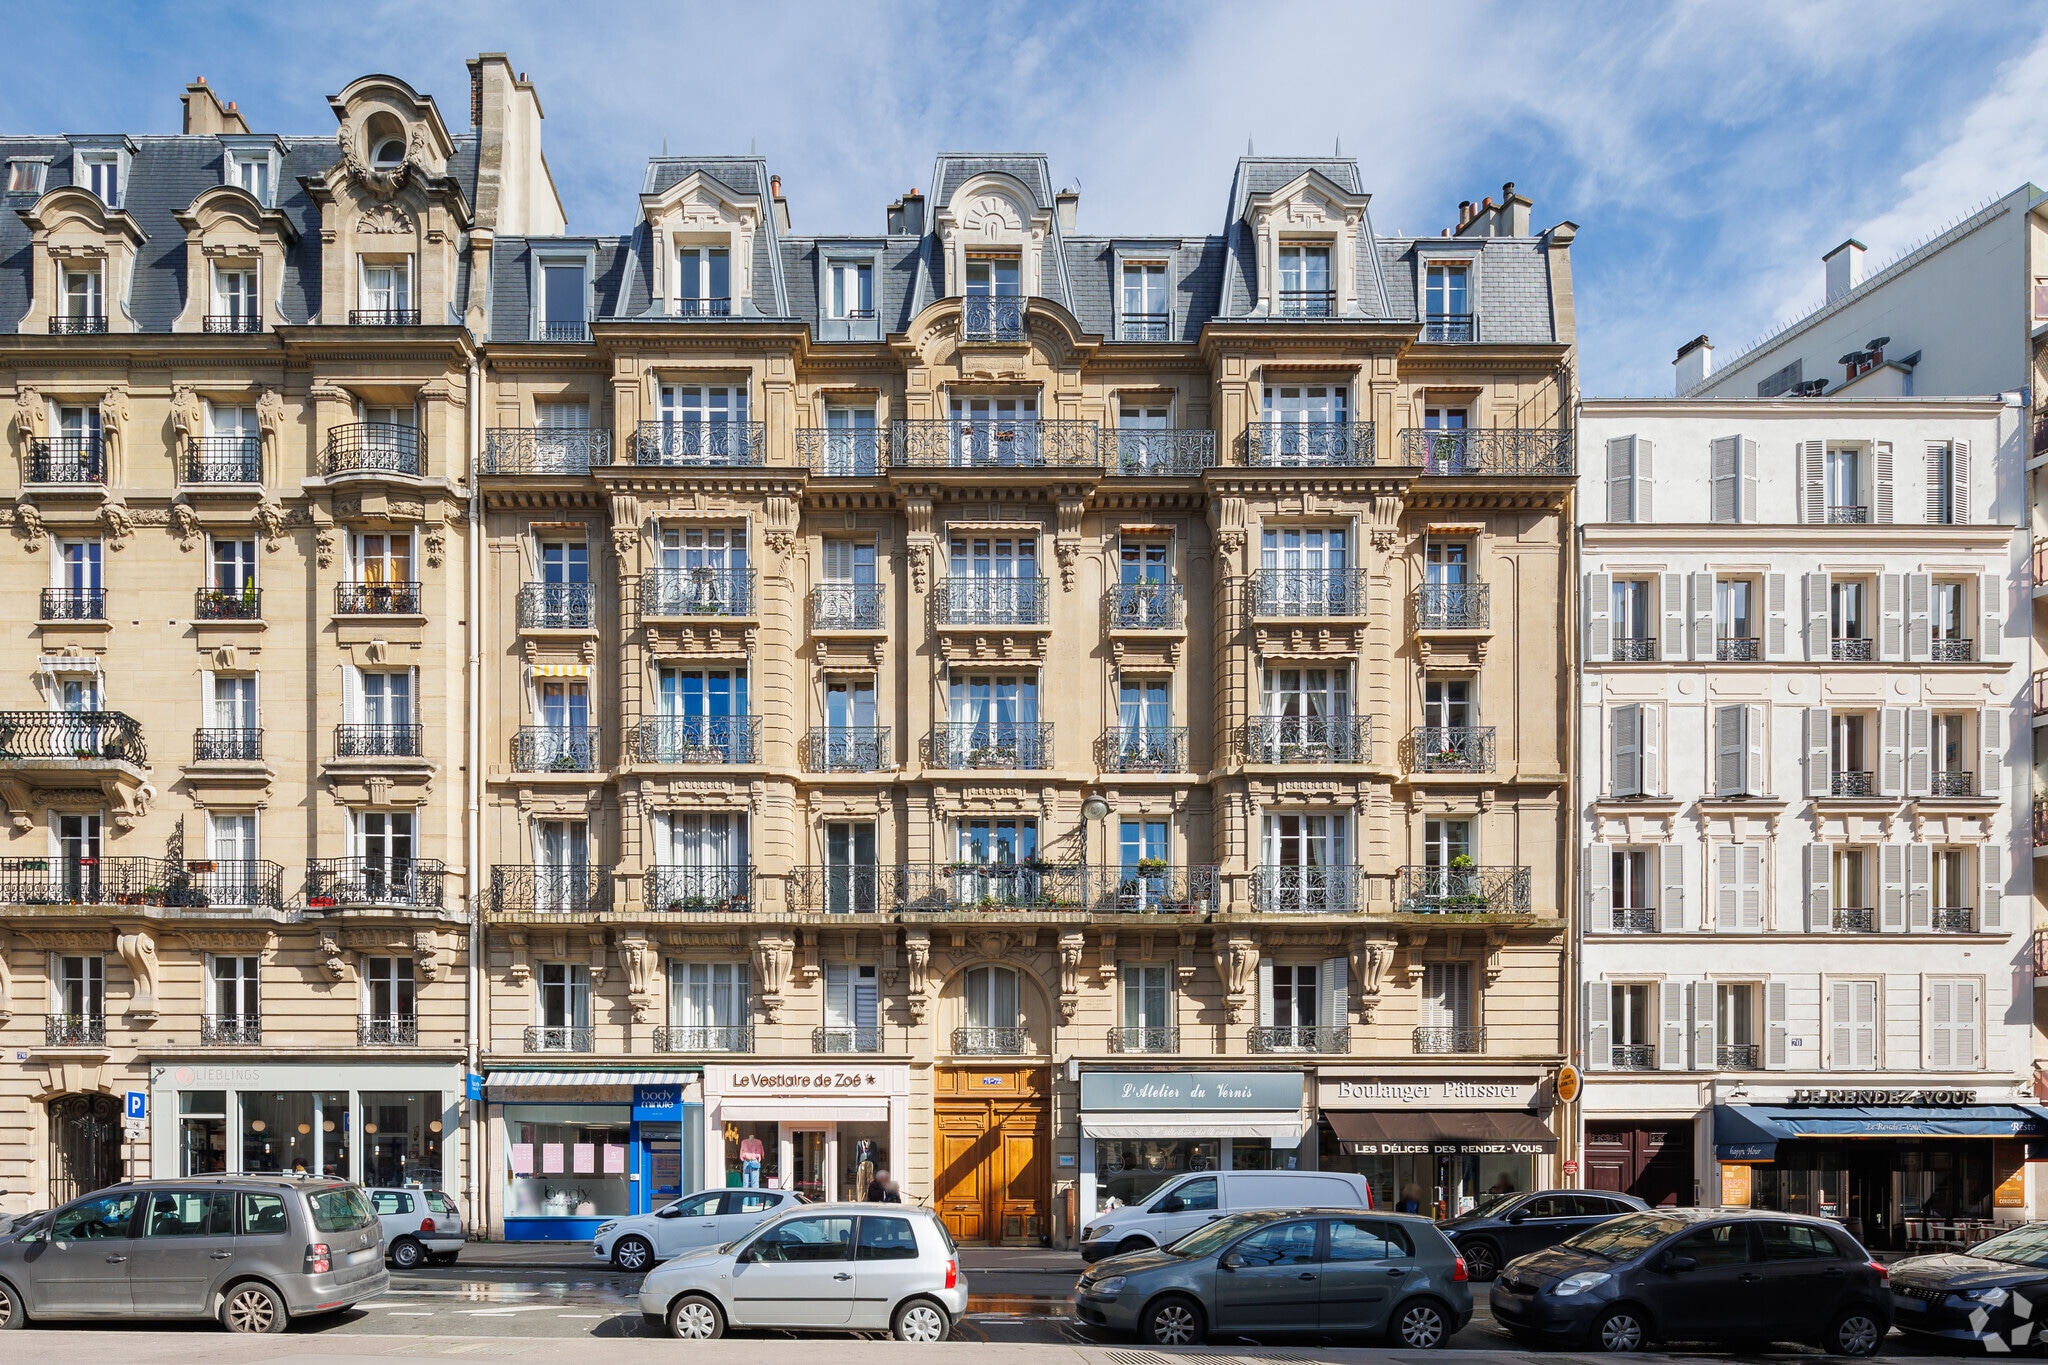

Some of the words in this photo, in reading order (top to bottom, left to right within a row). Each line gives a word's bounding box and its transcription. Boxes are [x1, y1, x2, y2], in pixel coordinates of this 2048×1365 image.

[732, 1073, 750, 1088] Le
[751, 1073, 811, 1088] Vestiaire
[813, 1073, 832, 1088] de
[834, 1073, 862, 1088] Zoé
[641, 1090, 675, 1101] body
[1121, 1082, 1180, 1098] L'Atelier
[1190, 1083, 1206, 1098] du
[1216, 1082, 1252, 1098] Vernis
[1338, 1080, 1432, 1102] Boulanger
[1442, 1080, 1520, 1099] Pâtissier
[1793, 1089, 1821, 1104] LE
[131, 1096, 141, 1114] P
[640, 1100, 675, 1109] minute
[2010, 1121, 2036, 1131] Resto
[1354, 1143, 1378, 1154] LES
[1381, 1142, 1430, 1154] DÉLICES
[1434, 1144, 1457, 1154] DES
